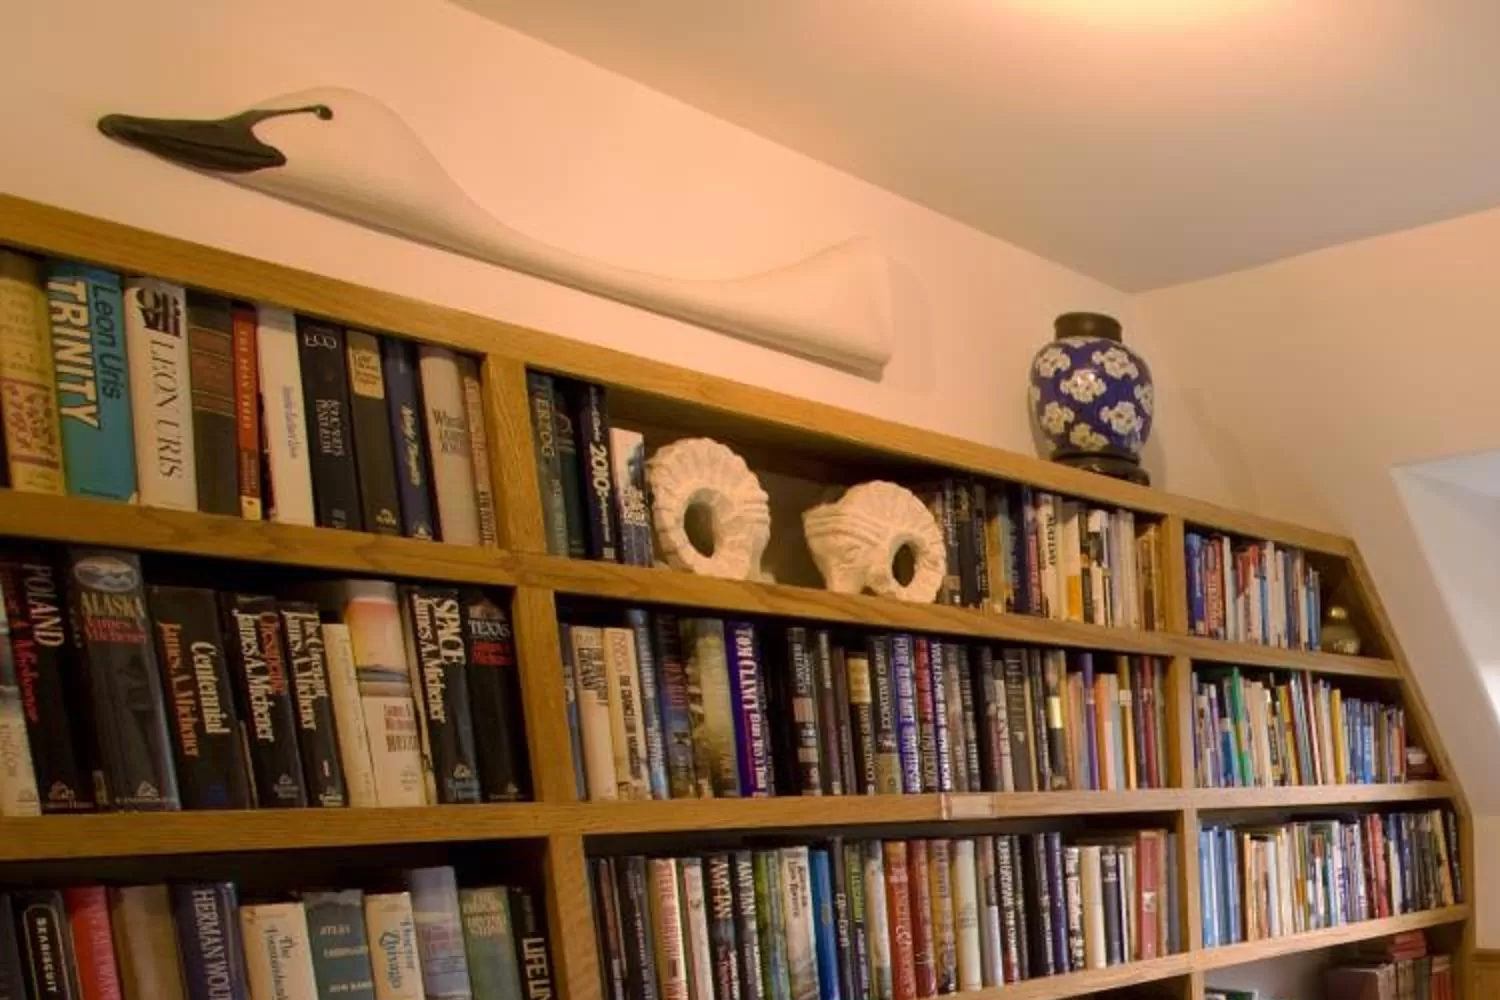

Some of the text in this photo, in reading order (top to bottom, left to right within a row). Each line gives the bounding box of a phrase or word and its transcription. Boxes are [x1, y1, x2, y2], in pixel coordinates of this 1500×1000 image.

[48, 277, 100, 430] TRINITY
[93, 286, 123, 400] Leon Uris
[149, 339, 180, 409] LEON
[305, 333, 337, 350] ECO
[155, 418, 183, 480] URIS
[22, 563, 64, 647] POLAND
[81, 591, 145, 618] ALASKA
[413, 594, 437, 639] James
[433, 597, 465, 666] SPACE
[157, 621, 184, 668] James
[173, 690, 199, 758] Michener
[190, 641, 231, 735] Centennial
[231, 609, 258, 656] James
[249, 675, 275, 743] Michener
[424, 659, 447, 725] Michener
[737, 861, 755, 887] AMY
[36, 917, 58, 992] SEABISCUIT
[192, 889, 222, 957] HERMAN
[280, 935, 298, 960] The
